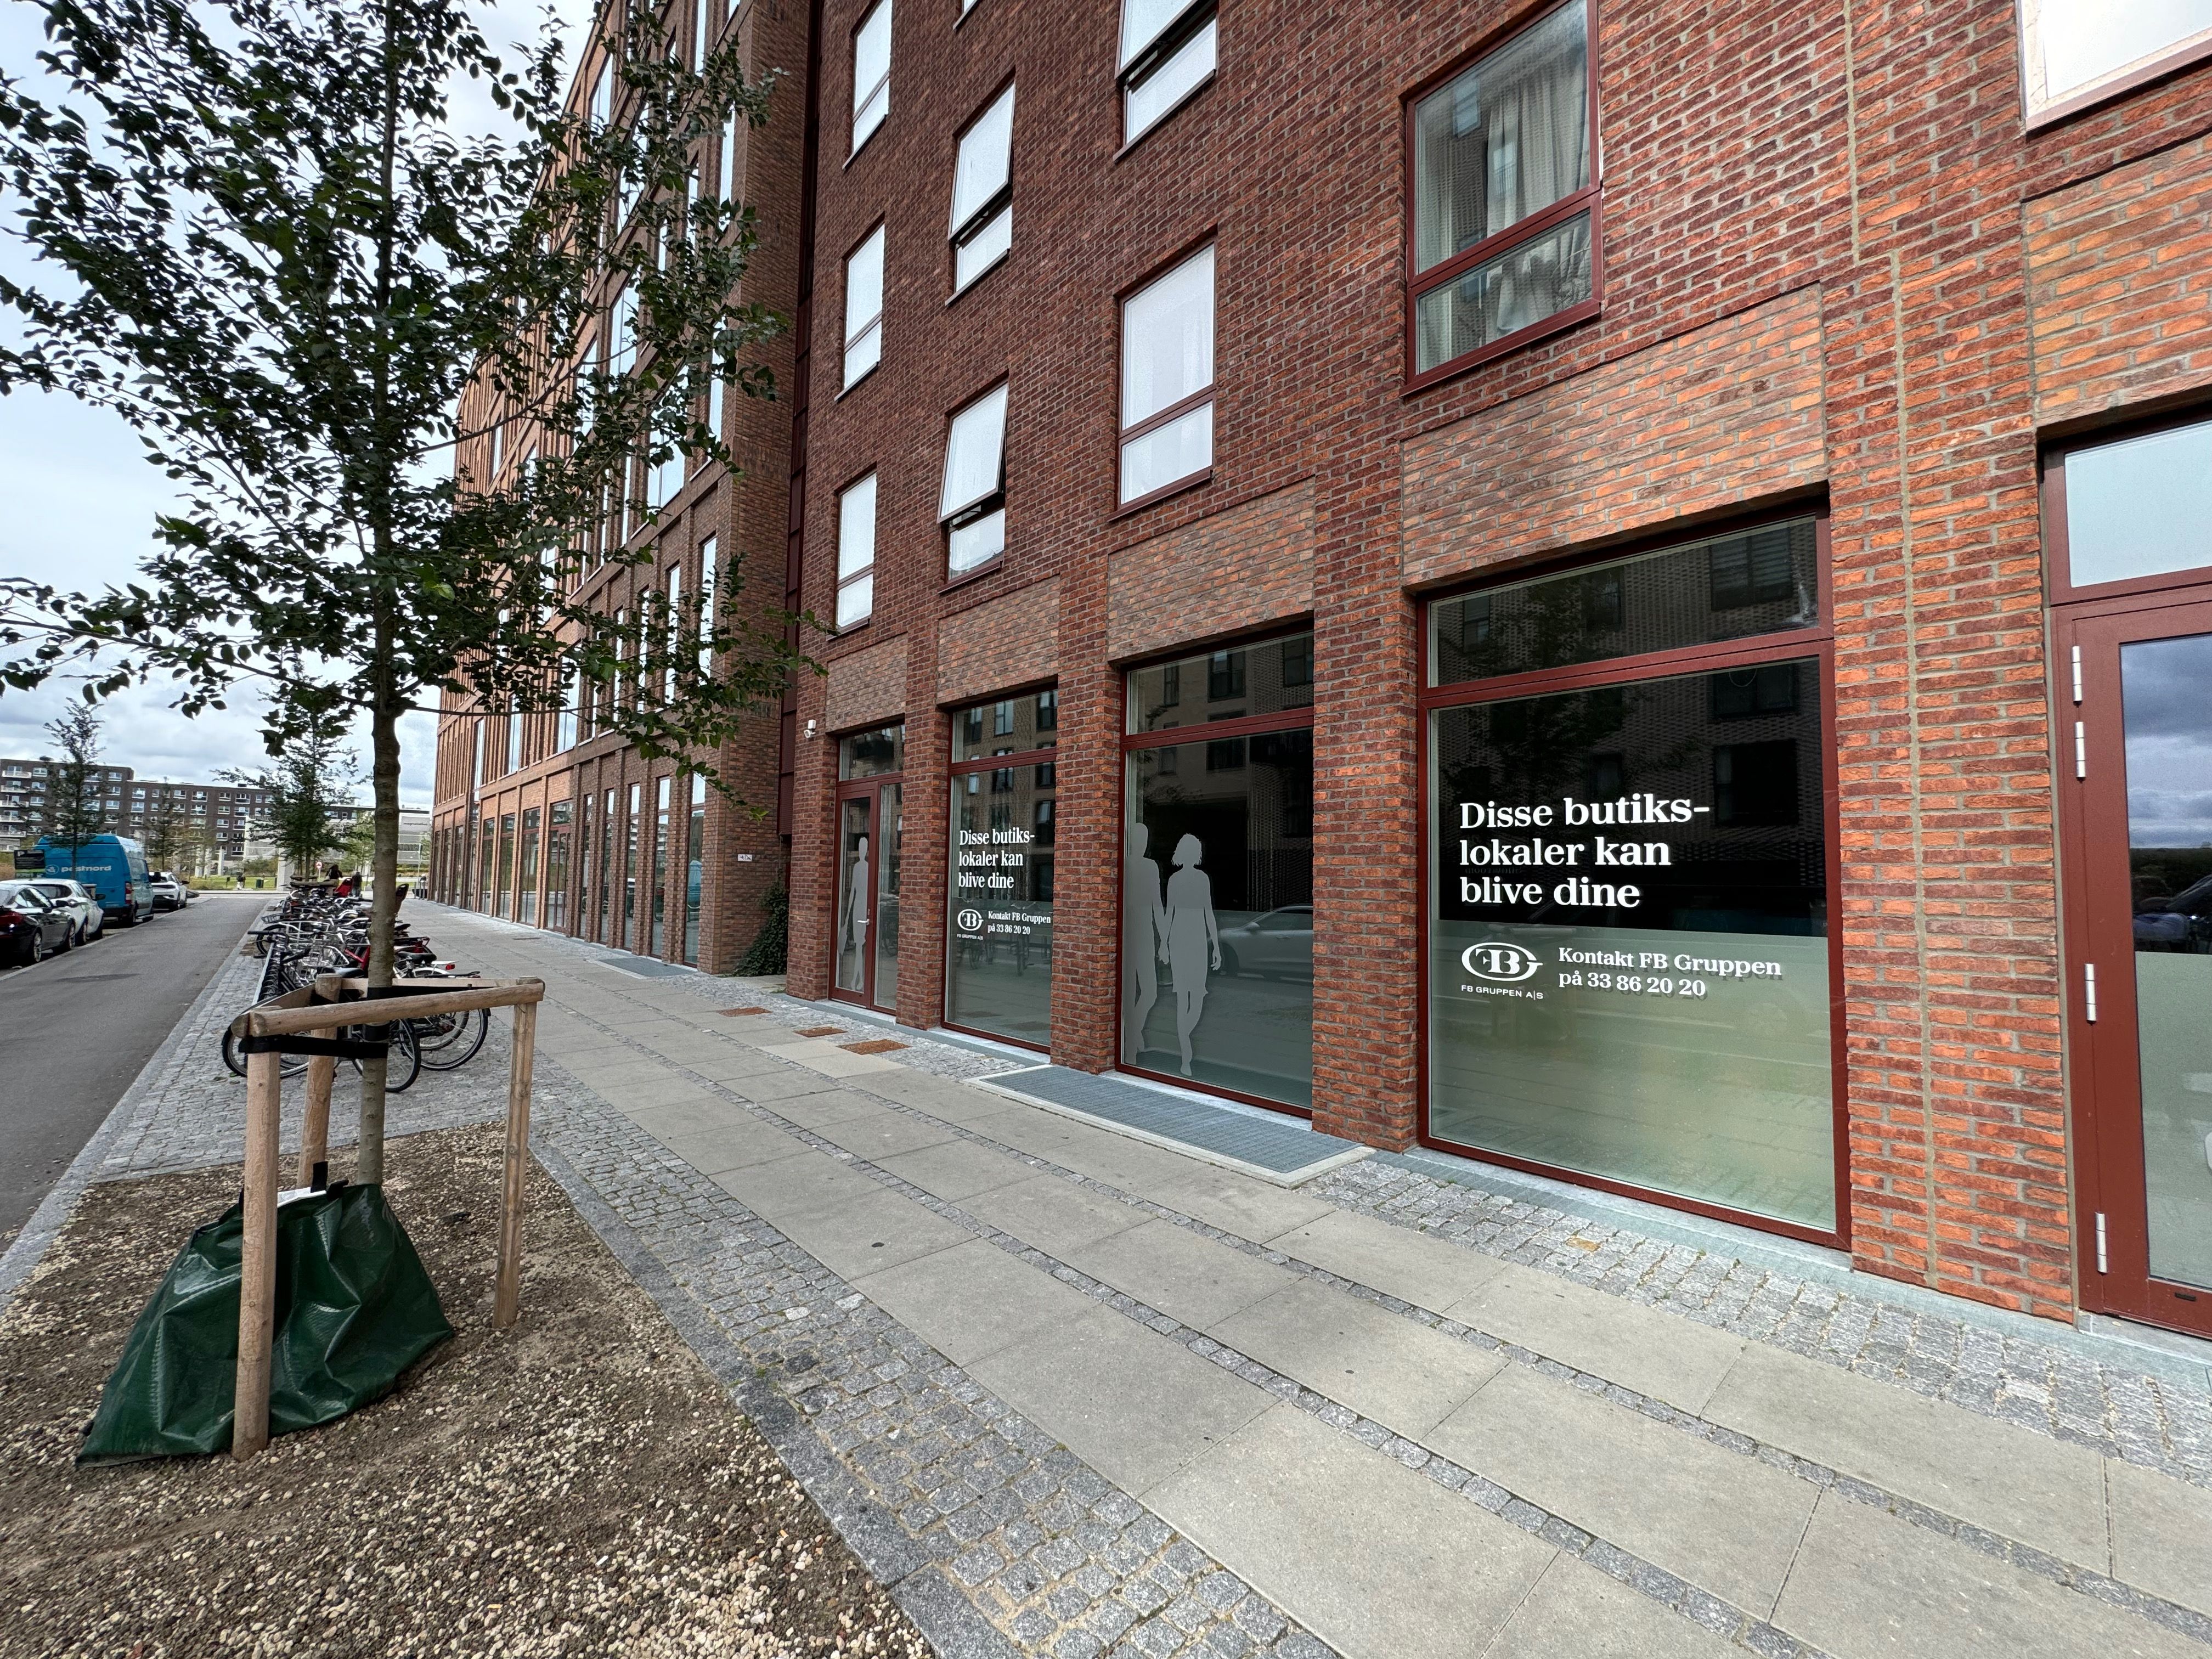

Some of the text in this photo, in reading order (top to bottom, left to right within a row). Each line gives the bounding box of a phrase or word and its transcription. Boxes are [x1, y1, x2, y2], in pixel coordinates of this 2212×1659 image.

[1460, 793, 1709, 828] Disse butiks-
[960, 827, 1035, 845] Disse butiks-
[958, 850, 1023, 866] lokaler kan
[1460, 837, 1672, 866] lokaler kan
[958, 872, 1014, 889] blive dine
[1460, 876, 1640, 908] blive dine
[988, 911, 1051, 925] Kontakt FB Gruppen
[988, 923, 1031, 935] på 33 86 20 20
[1559, 948, 1782, 977] Kontakt FB Gruppen
[1476, 986, 1522, 997] GRUPPEN
[1559, 970, 1707, 996] på 33 86 20 20
